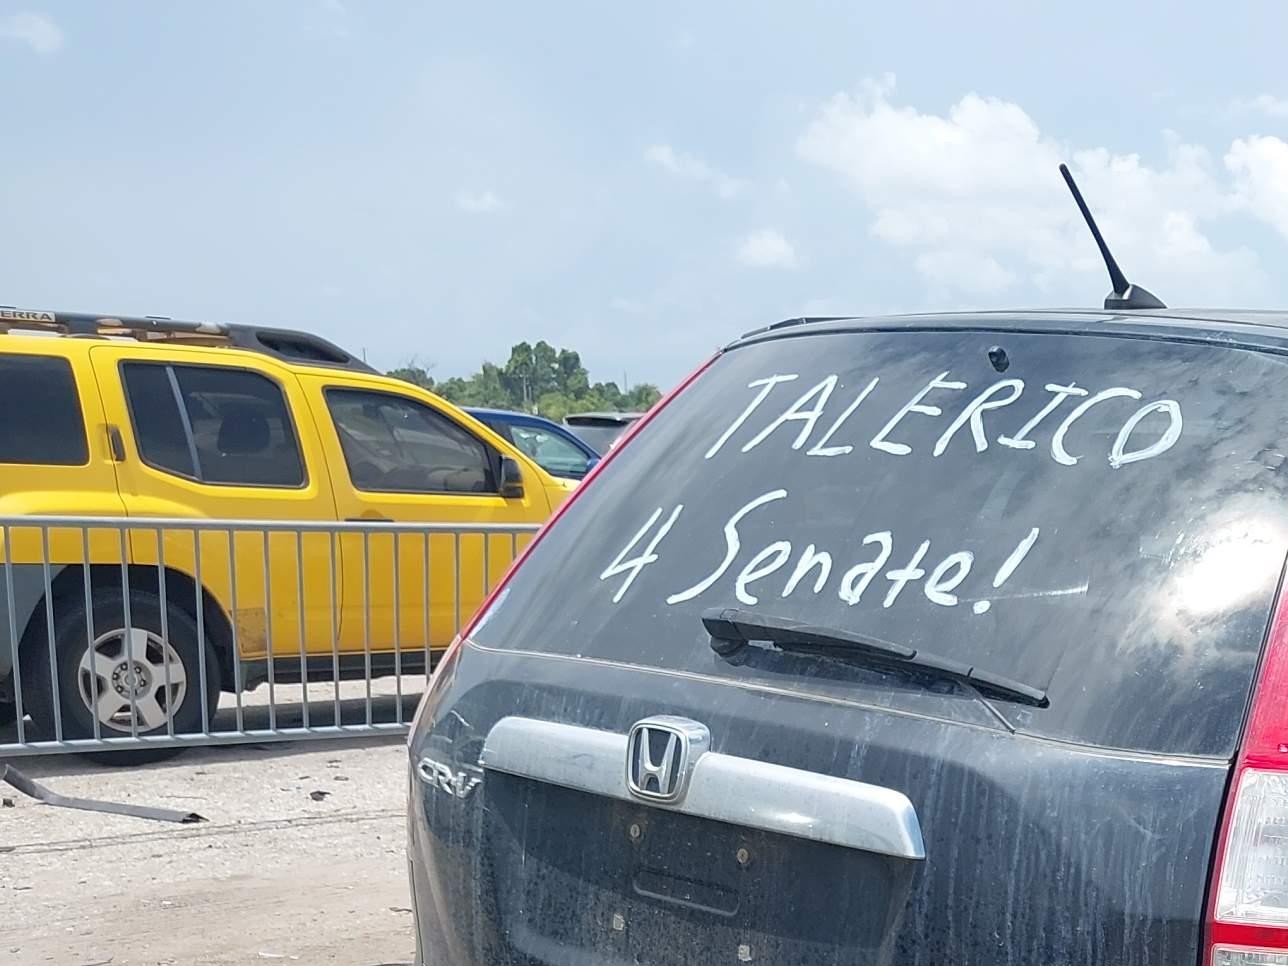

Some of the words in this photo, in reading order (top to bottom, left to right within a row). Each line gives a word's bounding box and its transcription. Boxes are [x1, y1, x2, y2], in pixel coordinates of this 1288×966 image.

[705, 371, 1183, 469] TALERICO
[600, 503, 684, 604] 4
[667, 489, 1041, 615] Senate!
